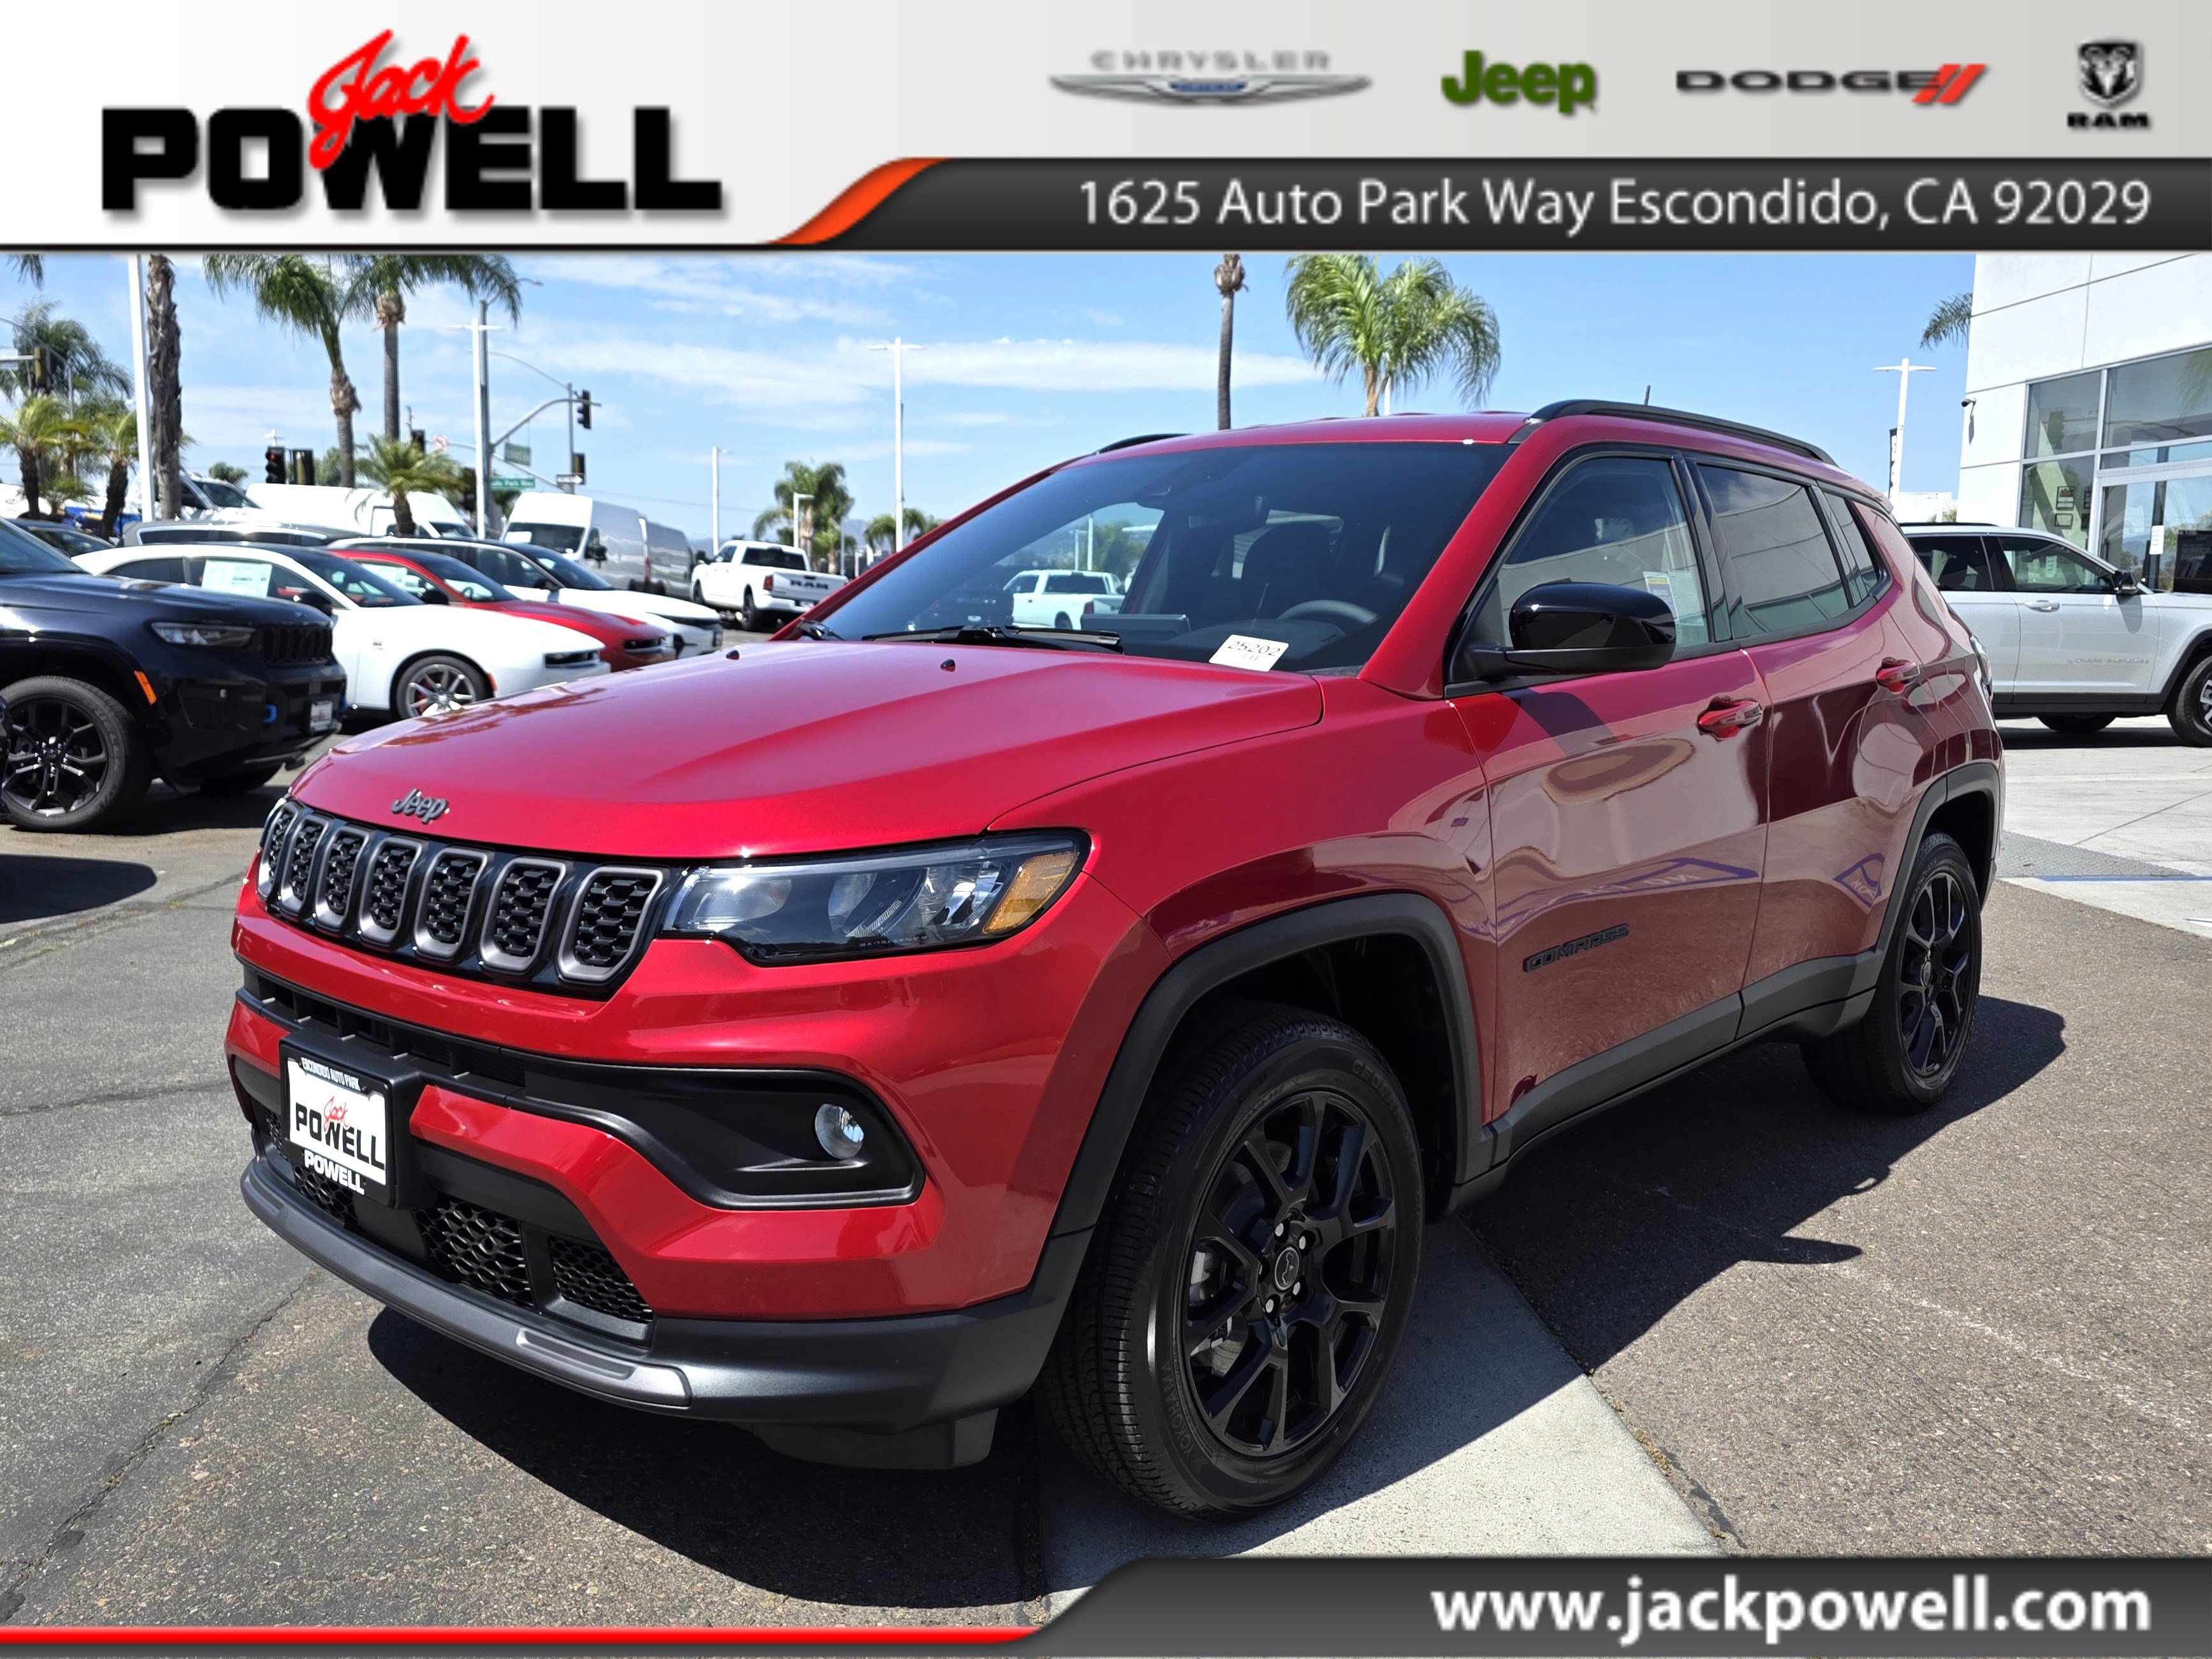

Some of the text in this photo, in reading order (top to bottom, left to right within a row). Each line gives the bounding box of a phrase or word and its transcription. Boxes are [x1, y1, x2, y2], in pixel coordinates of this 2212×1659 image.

[790, 579, 828, 589] RAM
[1228, 641, 1281, 656] 25202
[391, 788, 447, 825] Jeep
[1522, 922, 1630, 973] COMPASS
[323, 1095, 351, 1133] Jack
[295, 1101, 386, 1171] POWELL
[304, 1149, 365, 1196] POWELL
[1161, 1358, 1195, 1459] YOKOHAMA
